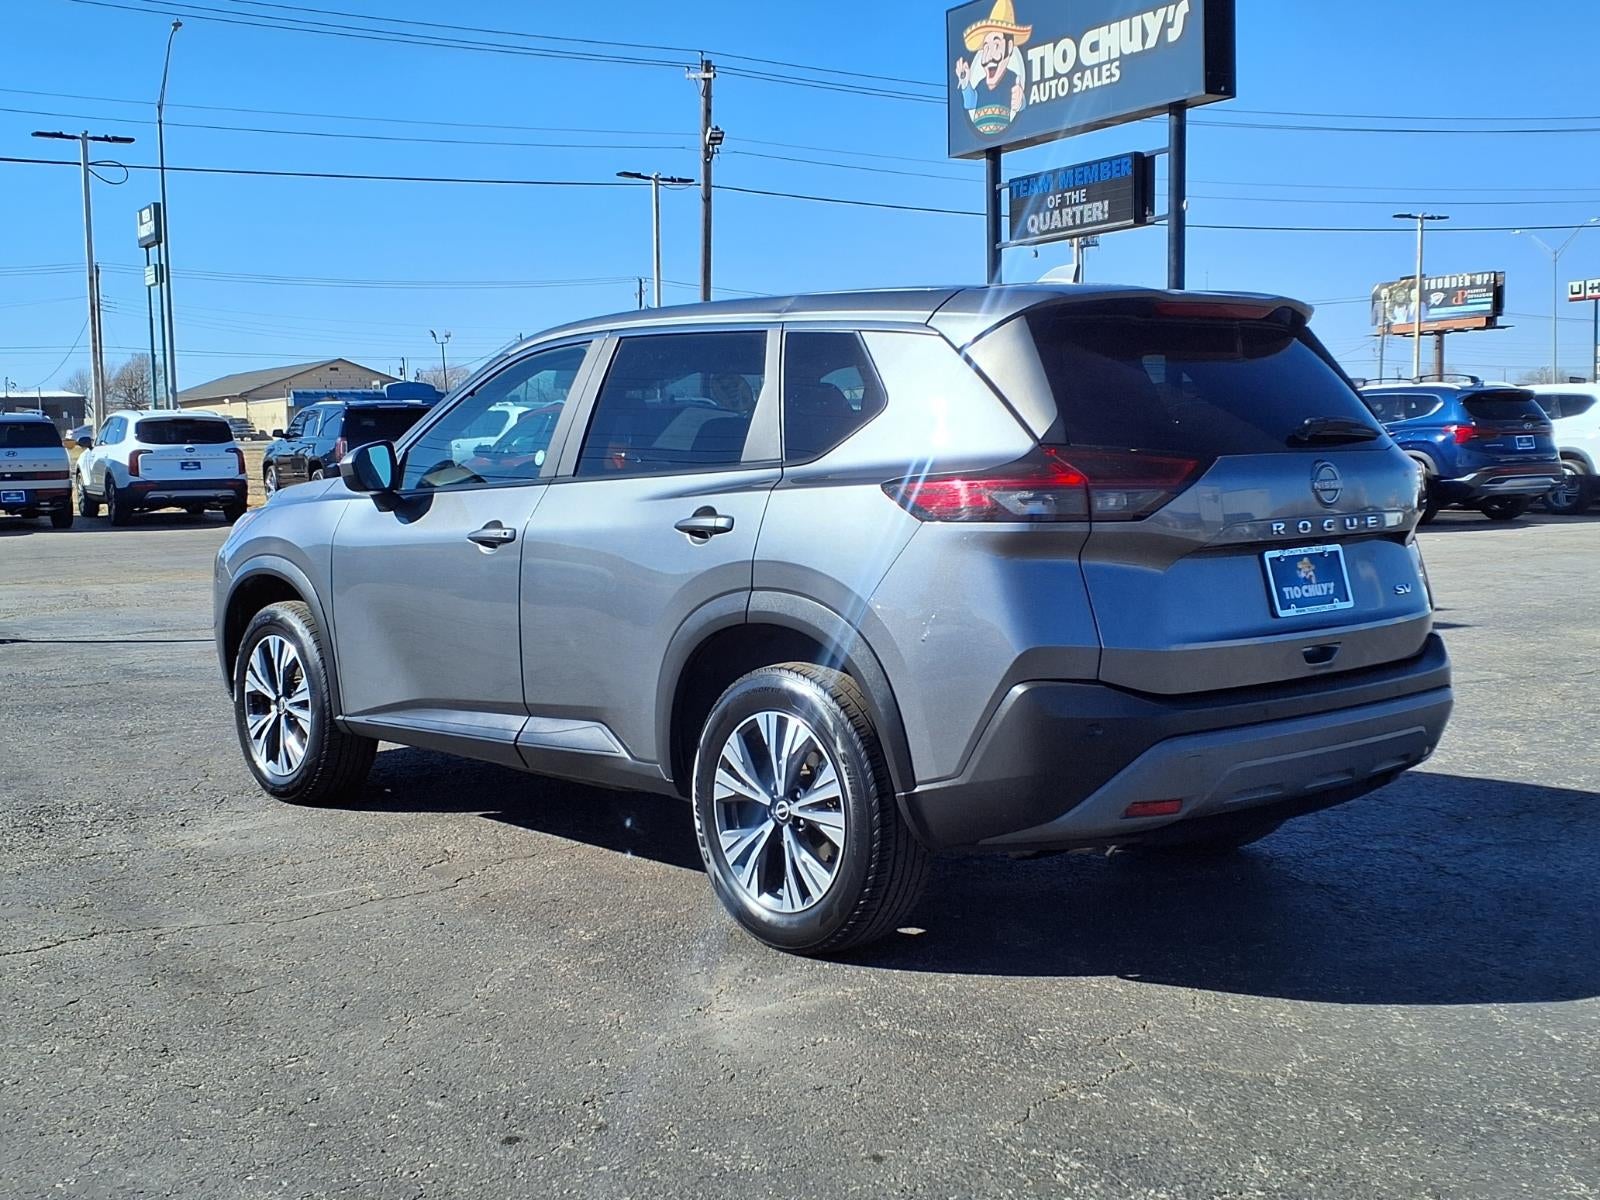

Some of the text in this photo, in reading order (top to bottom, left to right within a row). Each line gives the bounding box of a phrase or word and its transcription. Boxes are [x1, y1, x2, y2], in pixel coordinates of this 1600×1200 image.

[1027, 0, 1189, 82] TIO CHUY'S
[1029, 61, 1121, 105] AUTO SALES
[1009, 156, 1132, 198] TEAM MEMBER
[1047, 188, 1087, 208] OF THE
[1027, 200, 1109, 231] QUARTER!
[1272, 516, 1379, 535] ROGUE
[1282, 585, 1301, 600] TIO
[1395, 584, 1412, 594] SV
